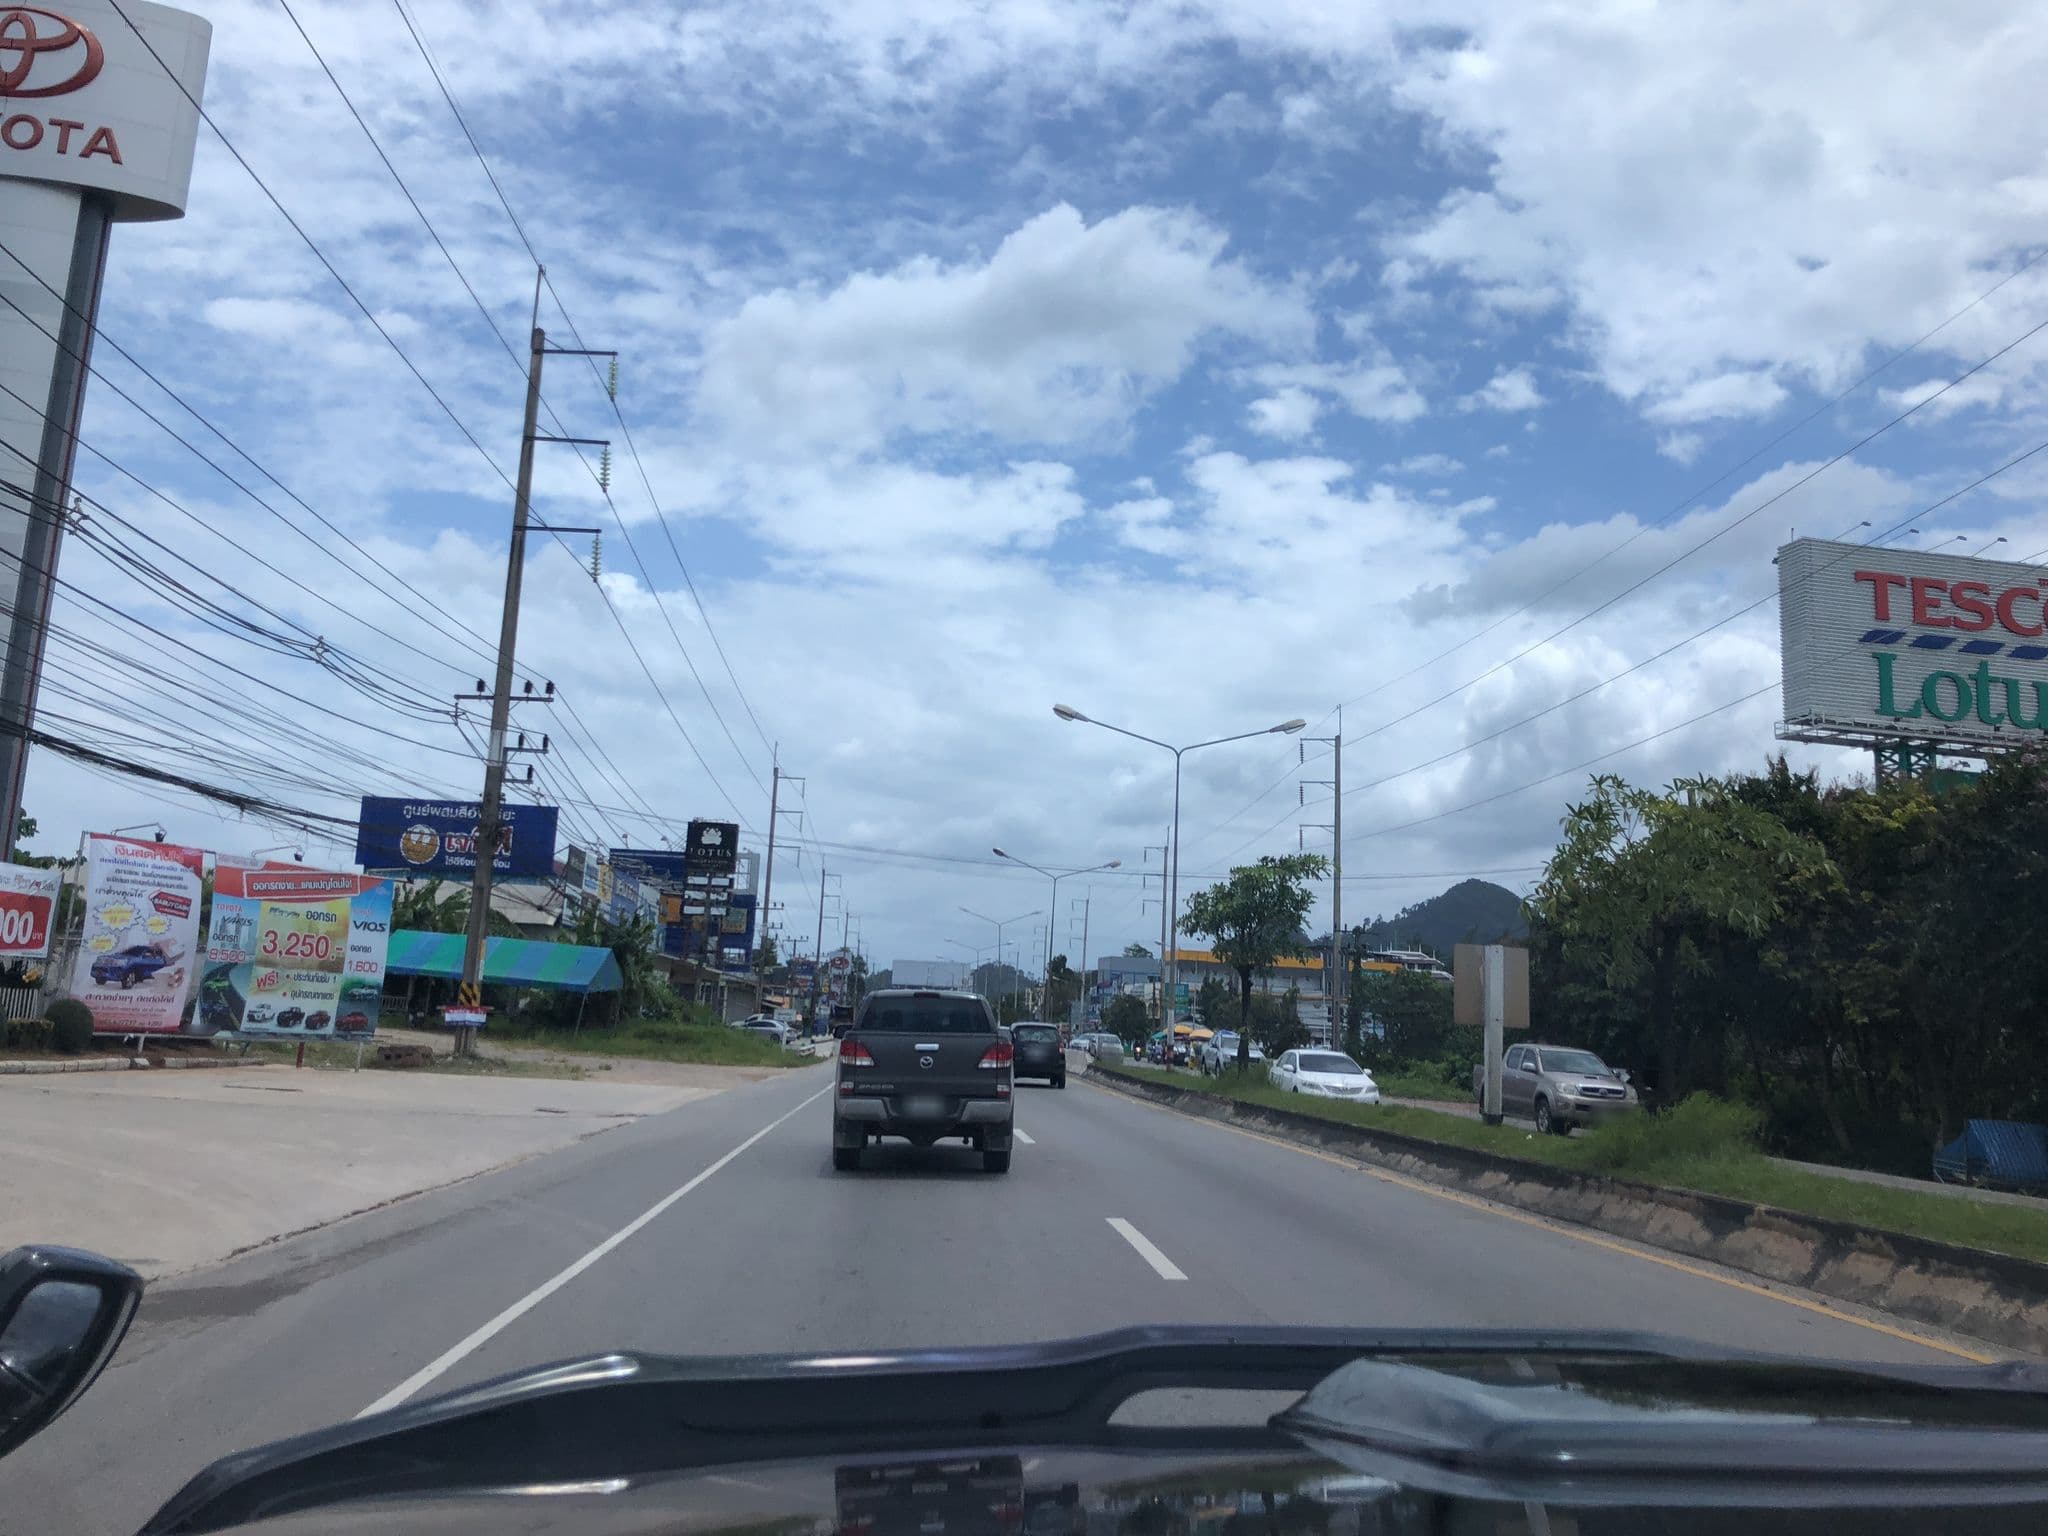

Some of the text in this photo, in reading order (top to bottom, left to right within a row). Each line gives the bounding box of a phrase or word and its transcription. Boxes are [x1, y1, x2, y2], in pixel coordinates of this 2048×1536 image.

[0, 114, 123, 165] OTA
[1854, 570, 2048, 637] TESC
[1872, 651, 2048, 730] Lotu
[690, 847, 732, 857] LOTUS
[216, 903, 243, 912] TOYOTA
[306, 910, 337, 923] ออกรถ
[353, 920, 387, 932] VIOS
